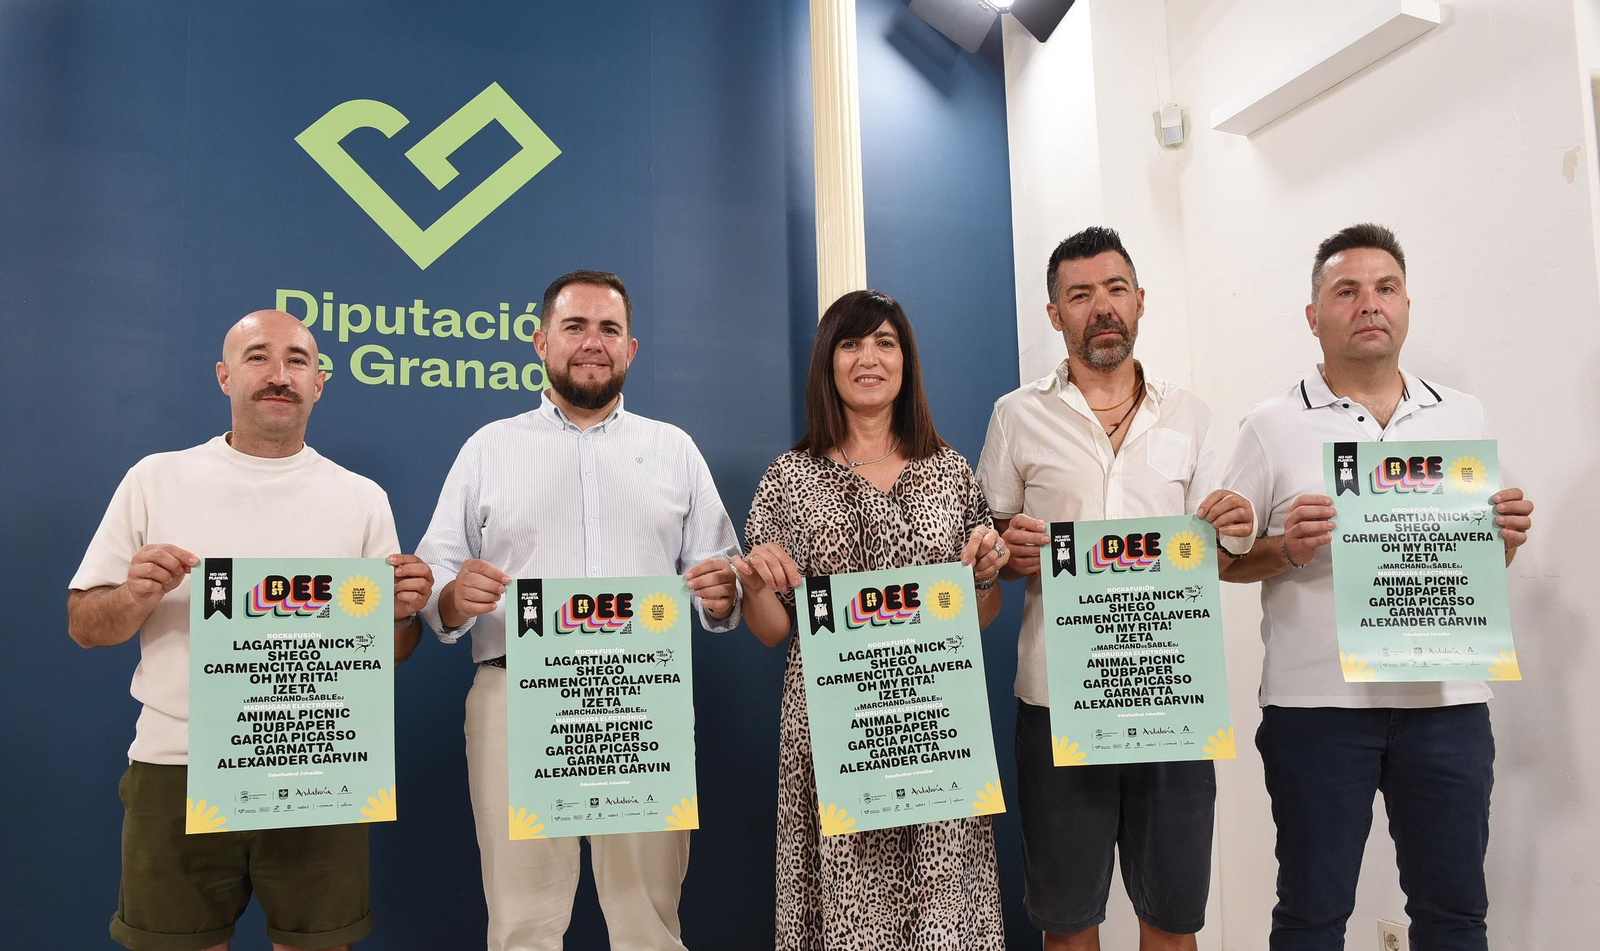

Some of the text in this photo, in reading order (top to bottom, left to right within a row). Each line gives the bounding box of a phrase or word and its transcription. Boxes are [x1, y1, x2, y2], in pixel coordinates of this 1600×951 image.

[275, 289, 541, 343] Diputació
[350, 344, 551, 391] Granad
[1385, 456, 1443, 480] DEE
[1392, 506, 1439, 514] ROCK&FUSIÓN
[1365, 513, 1435, 523] LAGARTIJA
[1438, 512, 1469, 522] NICK
[1395, 523, 1440, 532] SHEGO
[1343, 532, 1494, 543] CARMENCITA CALAVERA
[1103, 533, 1161, 558] DEE
[1381, 543, 1457, 553] OH MY RITA!
[1402, 553, 1439, 562] IZETA
[1419, 568, 1463, 576] ELECTRÓNICA
[1373, 576, 1469, 586] ANIMAL PICNIC
[266, 575, 332, 601] DEE
[1107, 585, 1155, 594] ROCK&FUSIÓN
[1386, 587, 1457, 596] DUBPAPER
[860, 583, 921, 612] DEE
[866, 592, 876, 600] FE
[1079, 592, 1151, 604] LAGARTIJA
[1153, 590, 1185, 600] NICK
[1369, 594, 1475, 607] GARCÍA PICASSO
[573, 593, 633, 619] DEE
[578, 599, 588, 607] FE
[867, 599, 877, 607] ST
[1109, 602, 1155, 613] SHEGO
[1056, 609, 1210, 626] CARMENCITA CALAVERA
[1389, 607, 1457, 617] GARNATTA
[1095, 621, 1172, 634] OH MY RITA!
[1360, 616, 1487, 627] ALEXANDER GARVIN
[267, 632, 322, 640] ROCK&FUSIÓN
[1116, 632, 1153, 643] IZETA
[233, 639, 316, 651] LAGARTIJA
[319, 638, 354, 649] NICK
[868, 638, 916, 649] ROCK&FUSIÓN
[268, 650, 321, 661] SHEGO
[575, 647, 625, 656] ROCK&FUSIÓN
[839, 641, 946, 662] LAGARTIJA NICK
[1134, 647, 1179, 656] ELECTRÓNICA
[545, 655, 620, 666] LAGARTIJA
[623, 653, 655, 664] NICK
[870, 655, 917, 669] SHEGO
[1087, 654, 1185, 668] ANIMAL PICNIC
[204, 660, 381, 674] CARMENCITA CALAVERA
[576, 665, 624, 676] SHEGO
[817, 659, 973, 686] CARMENCITA CALAVERA
[1101, 665, 1173, 678] DUBPAPER
[250, 672, 337, 684] OH MY RITA!
[520, 674, 680, 689] CARMENCITA CALAVERA
[857, 674, 935, 692] OH MY RITA!
[1083, 674, 1192, 689] GARCÍA PICASSO
[273, 684, 316, 695] IZETA
[561, 686, 641, 698] OH MY RITA!
[879, 687, 917, 701] IZETA
[1104, 686, 1173, 698] GARNATTA
[292, 700, 344, 709] ELECTRÓNICA
[582, 697, 621, 708] IZETA
[1074, 694, 1204, 710] ALEXANDER GARVIN
[237, 708, 350, 722] ANIMAL PICNIC
[855, 701, 943, 718] MADRUGADA ELECTRÓNICA
[600, 713, 647, 722] ELECTRÓNICA
[851, 708, 950, 729] ANIMAL PICNIC
[253, 720, 335, 733] DUBPAPER
[550, 720, 653, 734] ANIMAL PICNIC
[865, 720, 938, 738] DUBPAPER
[231, 730, 356, 745] GARCÍA PICASSO
[565, 732, 640, 744] DUBPAPER
[848, 729, 957, 751] GARCÍA PICASSO
[255, 742, 334, 756] GARNATTA
[546, 741, 659, 756] GARCÍA PICASSO
[870, 742, 940, 759] GARNATTA
[218, 751, 367, 769] ALEXANDER GARVIN
[567, 753, 639, 766] GARNATTA
[840, 755, 918, 774] ALEXANDER
[921, 748, 971, 763] GARVIN
[535, 762, 670, 779] ALEXANDER GARVIN
